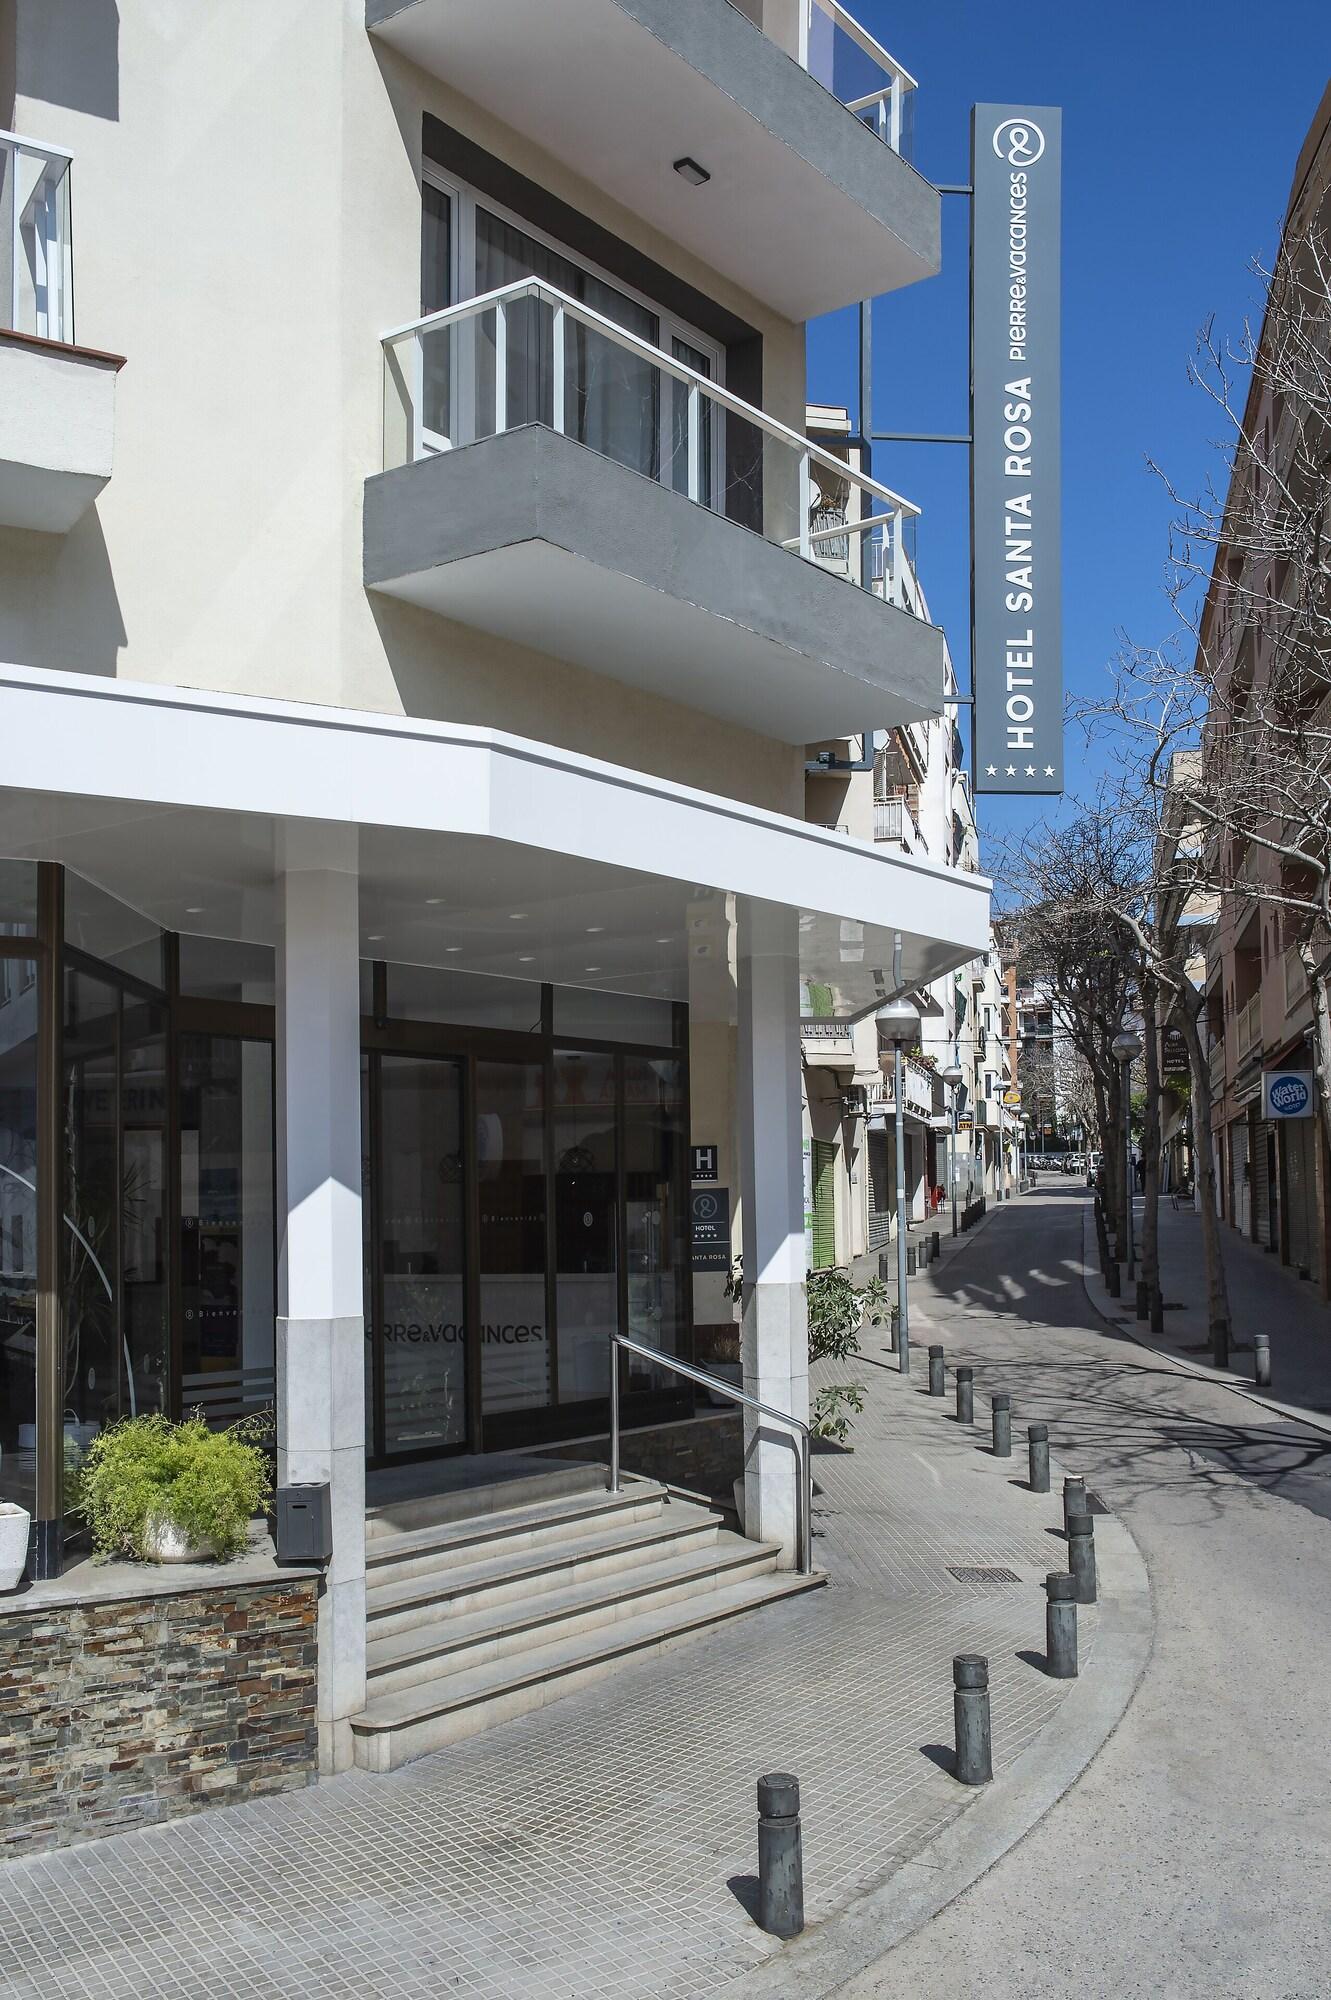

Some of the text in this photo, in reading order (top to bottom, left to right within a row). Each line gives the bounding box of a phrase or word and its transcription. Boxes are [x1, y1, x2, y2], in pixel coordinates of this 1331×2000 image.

[1003, 377, 1034, 749] HOTEL SANTA ROSA
[1271, 1083, 1305, 1098] Water
[1272, 1088, 1307, 1108] World
[695, 1148, 712, 1170] H
[708, 1253, 727, 1261] ROSA
